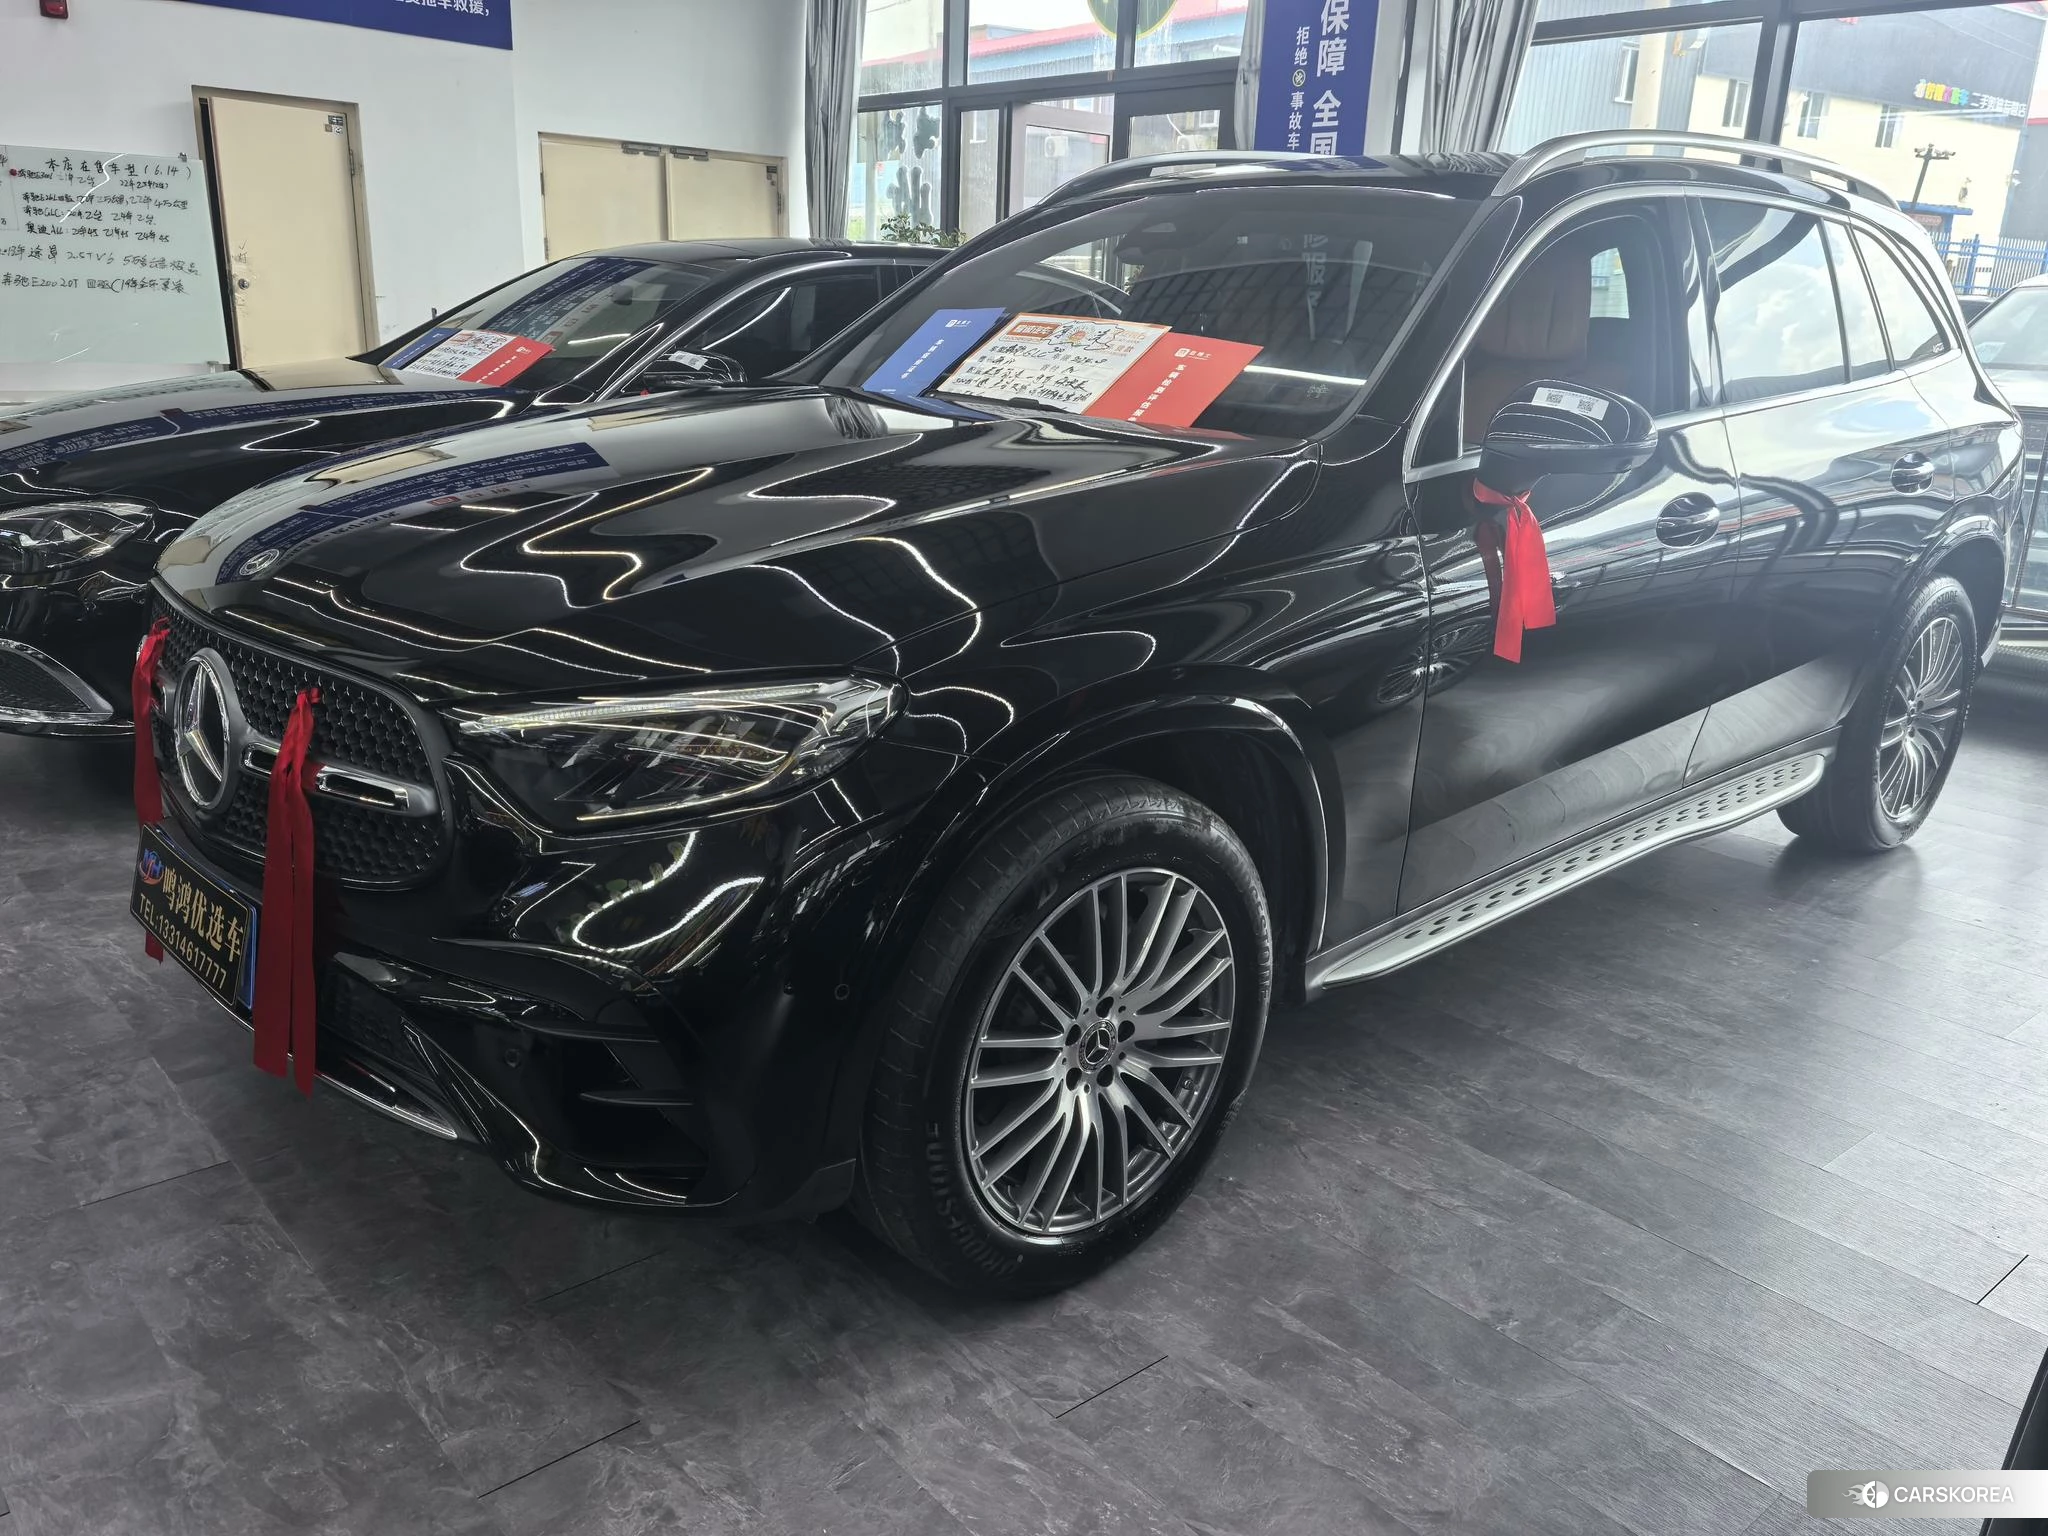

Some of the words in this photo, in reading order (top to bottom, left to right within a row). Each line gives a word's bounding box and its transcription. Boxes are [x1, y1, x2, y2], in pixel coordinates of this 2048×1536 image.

[395, 0, 490, 16] 车救援,
[1316, 0, 1350, 78] 保障
[1294, 26, 1311, 66] 拒绝
[1287, 91, 1305, 151] 事故车
[1309, 90, 1342, 155] 全国
[138, 892, 227, 990] TEL:13314617777
[162, 865, 244, 963] 鹏鸿优选车
